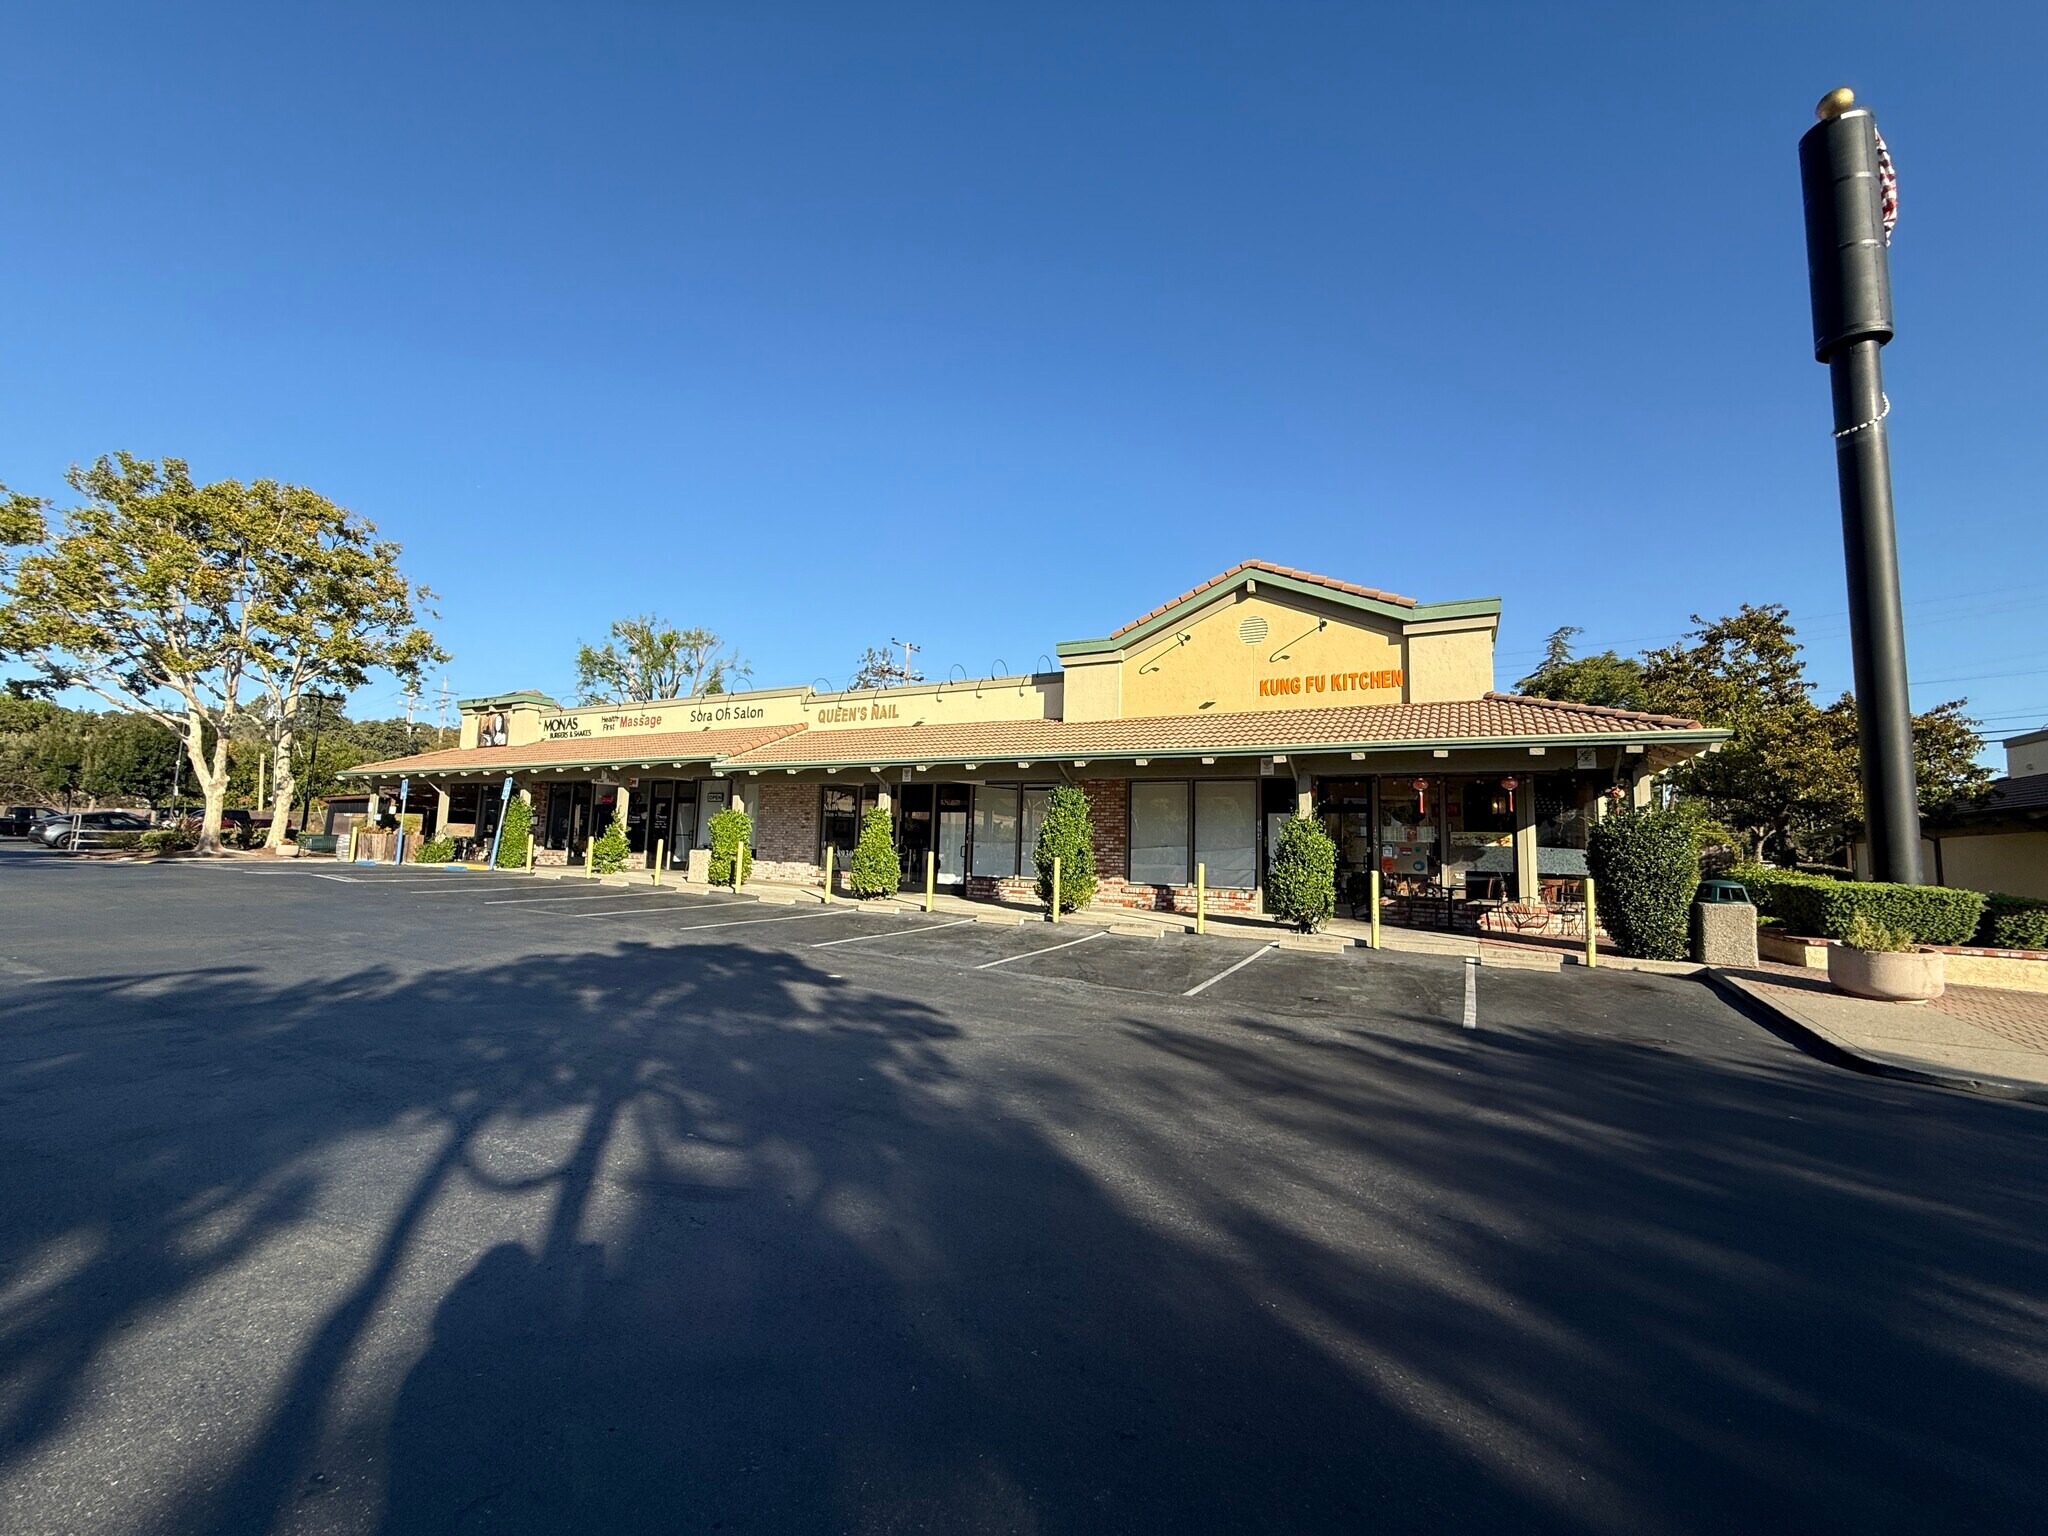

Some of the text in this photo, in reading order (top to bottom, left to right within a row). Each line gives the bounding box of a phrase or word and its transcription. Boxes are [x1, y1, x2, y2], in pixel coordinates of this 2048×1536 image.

[1259, 669, 1404, 696] KUNG FU KITCHEN
[619, 715, 662, 729] Massage
[690, 710, 713, 723] Sora
[733, 706, 764, 720] Salon
[818, 704, 899, 724] QUEEN'S NAIL
[543, 717, 578, 732] MONAS
